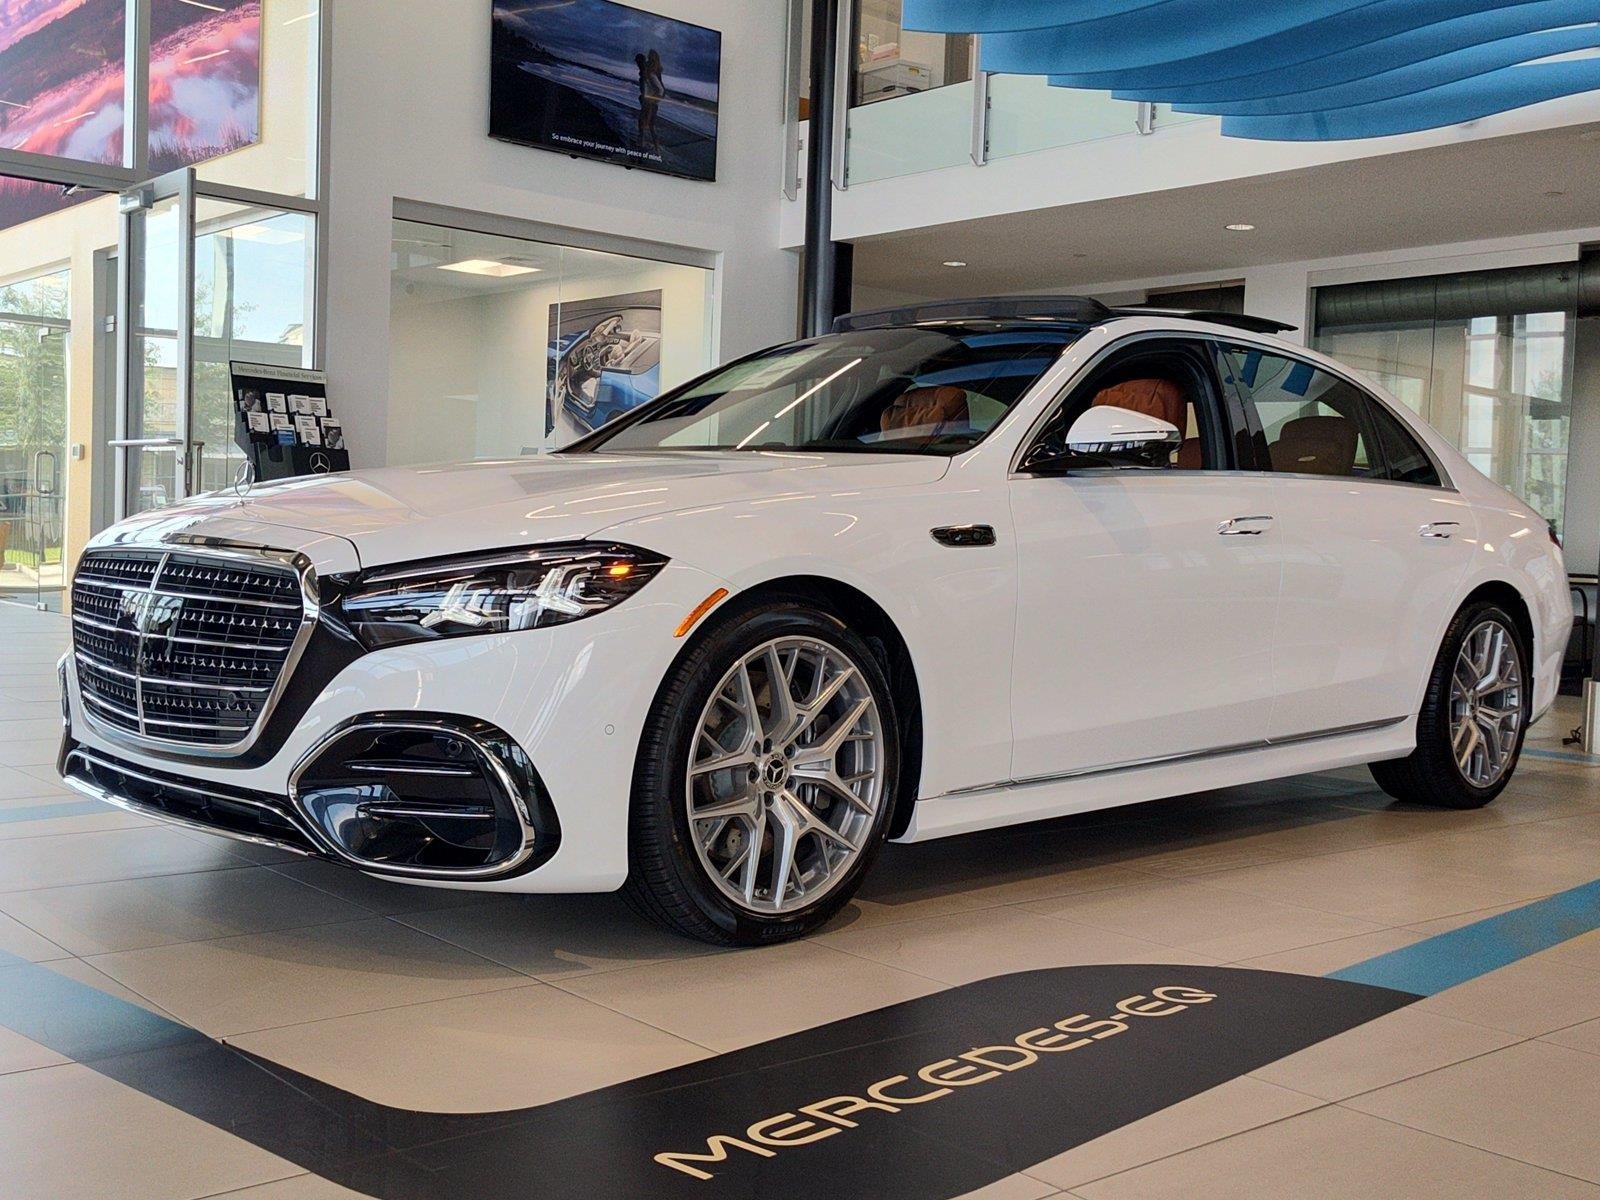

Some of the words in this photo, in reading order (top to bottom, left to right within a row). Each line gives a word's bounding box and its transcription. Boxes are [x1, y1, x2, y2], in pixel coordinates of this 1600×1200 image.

[560, 136, 583, 145] embrace
[595, 142, 614, 153] journey
[615, 147, 627, 155] with
[627, 150, 642, 158] peace
[653, 985, 1218, 1181] MERCEDES-EQ
